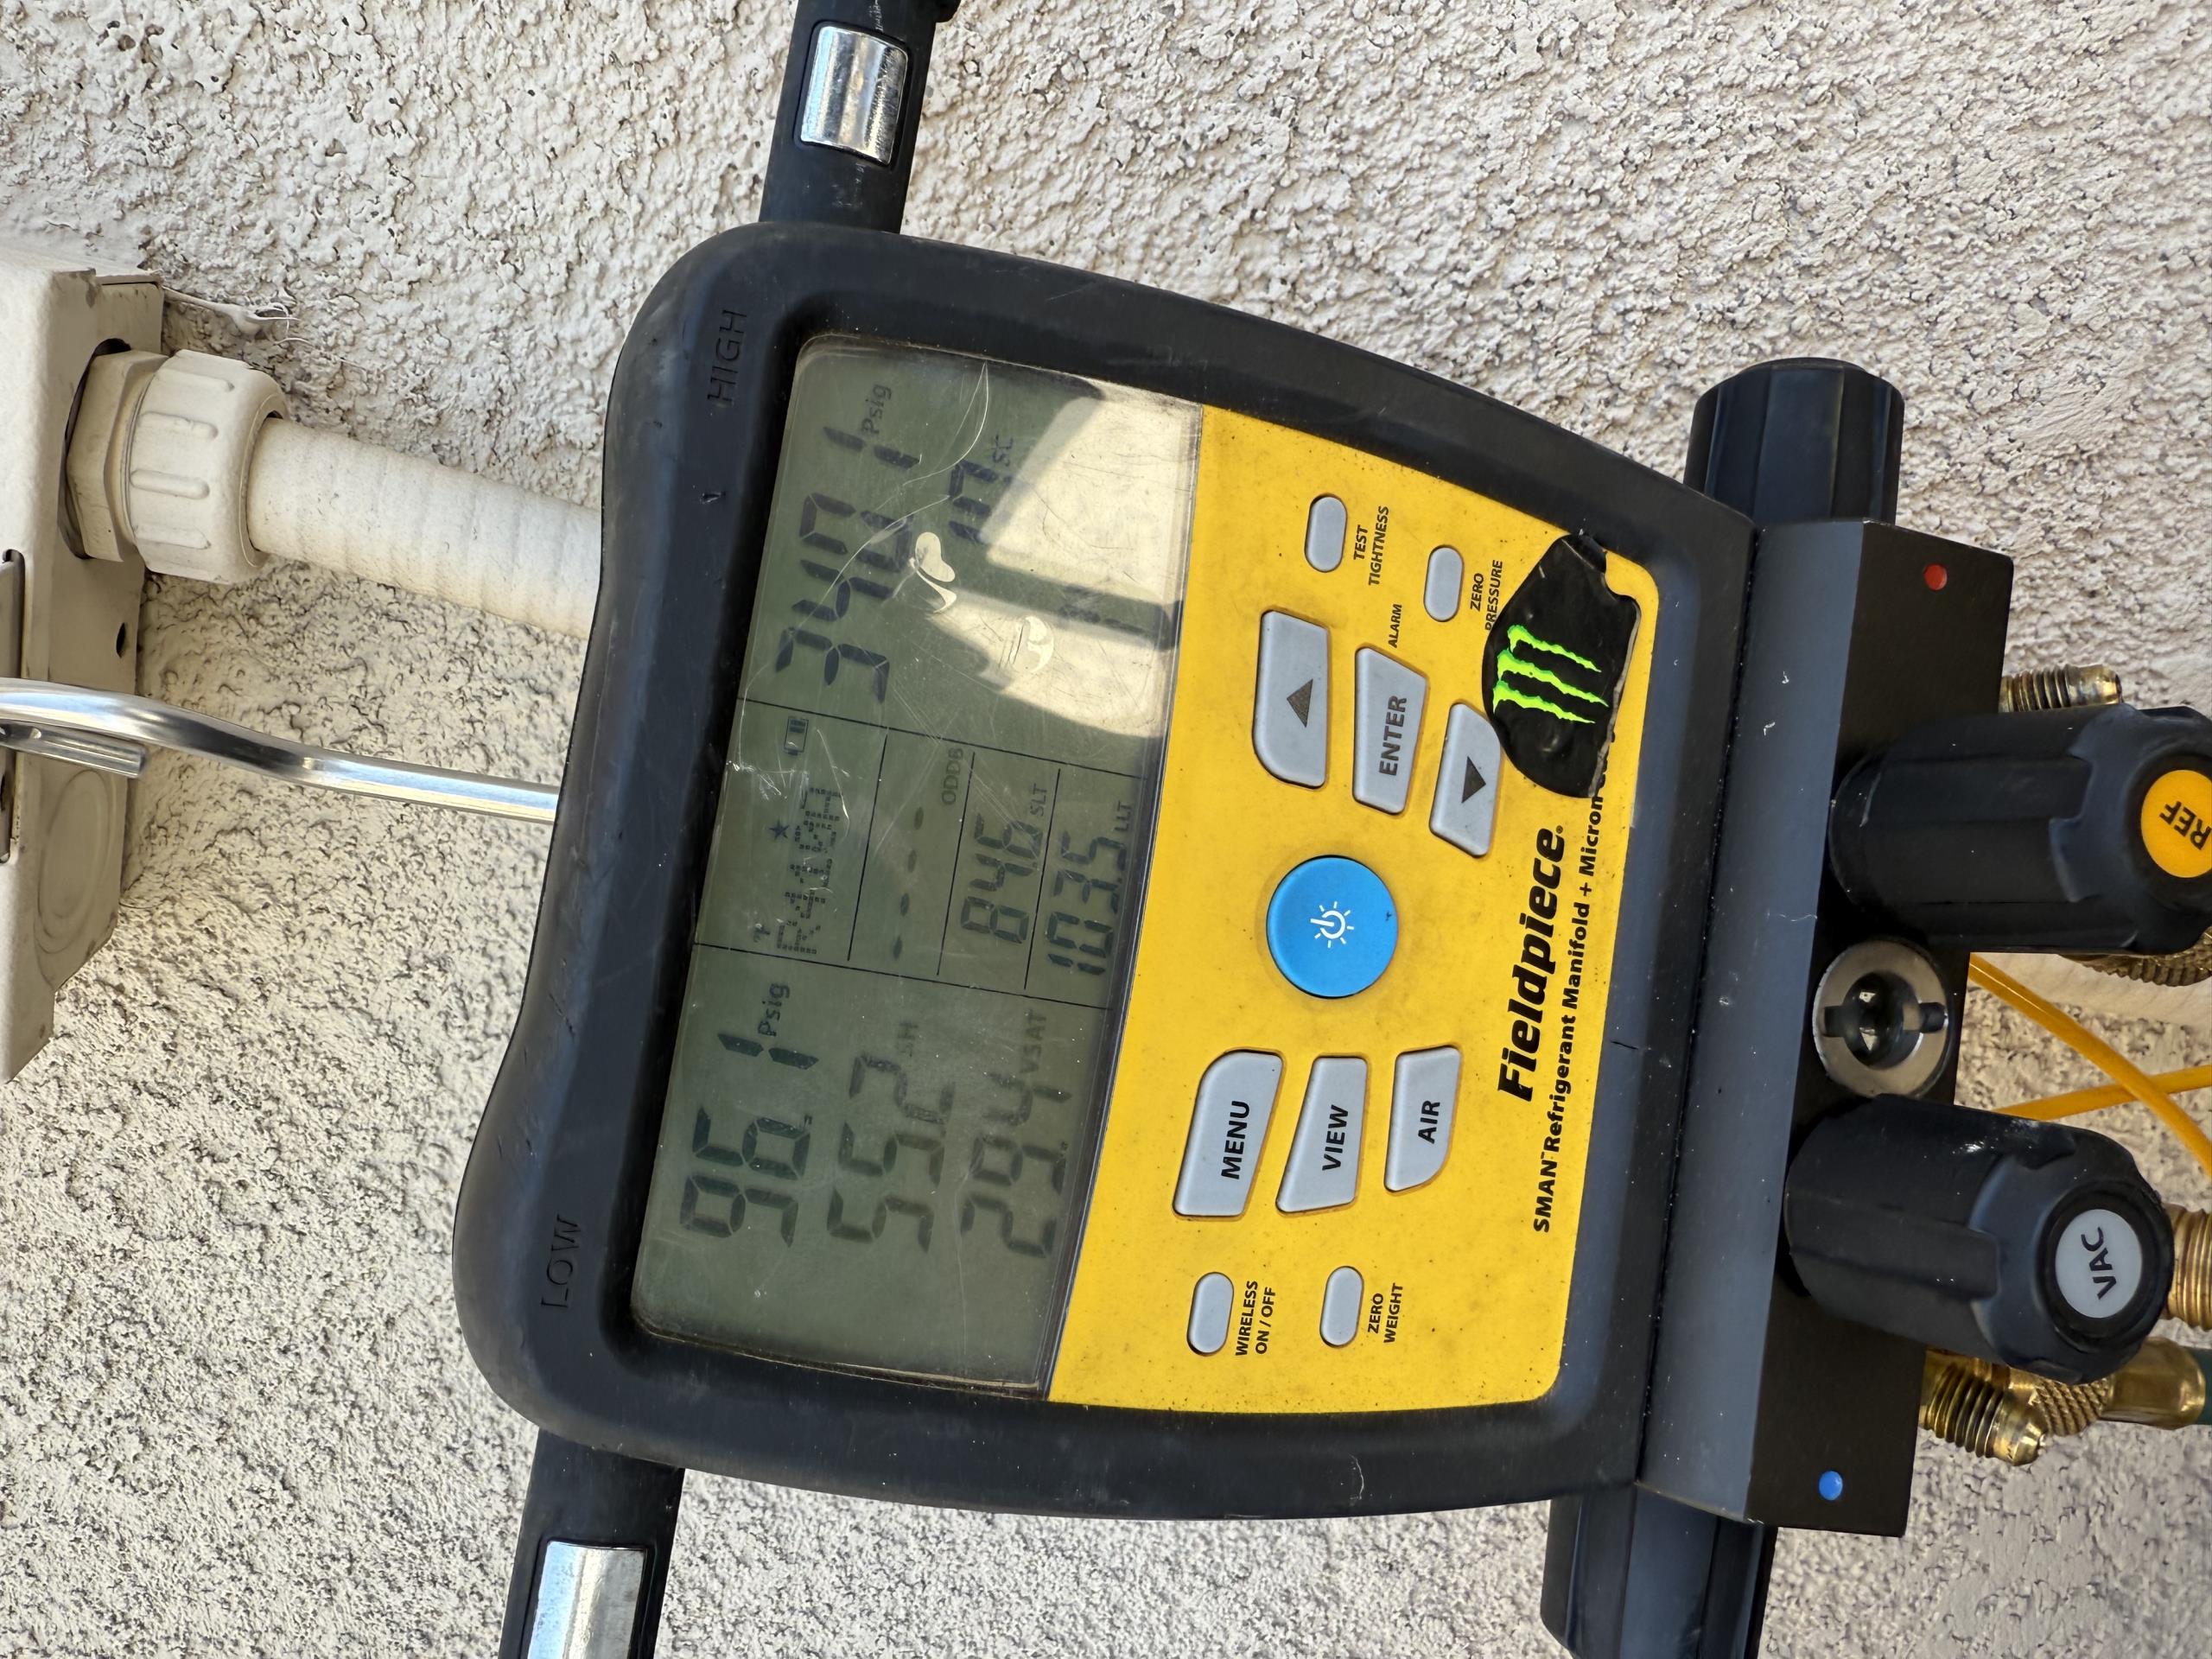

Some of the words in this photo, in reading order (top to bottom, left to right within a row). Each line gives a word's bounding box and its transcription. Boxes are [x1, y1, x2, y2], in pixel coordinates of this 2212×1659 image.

[708, 310, 747, 407] HIGH
[860, 383, 893, 435] Psig
[1353, 524, 1369, 561] TEST
[1368, 505, 1389, 586] TIGHTNESS
[1470, 571, 1484, 613] ZERO
[1484, 559, 1503, 631] PRESSURE
[1388, 603, 1403, 648] ALARM
[1378, 694, 1408, 777] ENTER
[941, 747, 964, 805] ODDB
[1029, 782, 1048, 817] SLT
[1114, 799, 1133, 832] LLT
[2158, 800, 2212, 851] REF
[1543, 1014, 1576, 1153] Refrigerant
[1561, 902, 1591, 1010] Manifold
[1578, 796, 1605, 877] Micron
[1020, 1009, 1048, 1074] VSAT
[679, 1031, 820, 1249] 96.1
[756, 982, 791, 1037] Psig
[1220, 1100, 1251, 1180] MENU
[1322, 1104, 1350, 1172] VIEW
[1417, 1100, 1441, 1145] AIR
[541, 1213, 583, 1311] LOW
[2081, 1226, 2117, 1300] VAC
[1235, 1281, 1258, 1356] WIRELESS
[1261, 1287, 1276, 1318] OFF
[1367, 1293, 1383, 1333] ZERO
[1382, 1282, 1404, 1344] WEIGHT
[1255, 1330, 1269, 1355] ON
